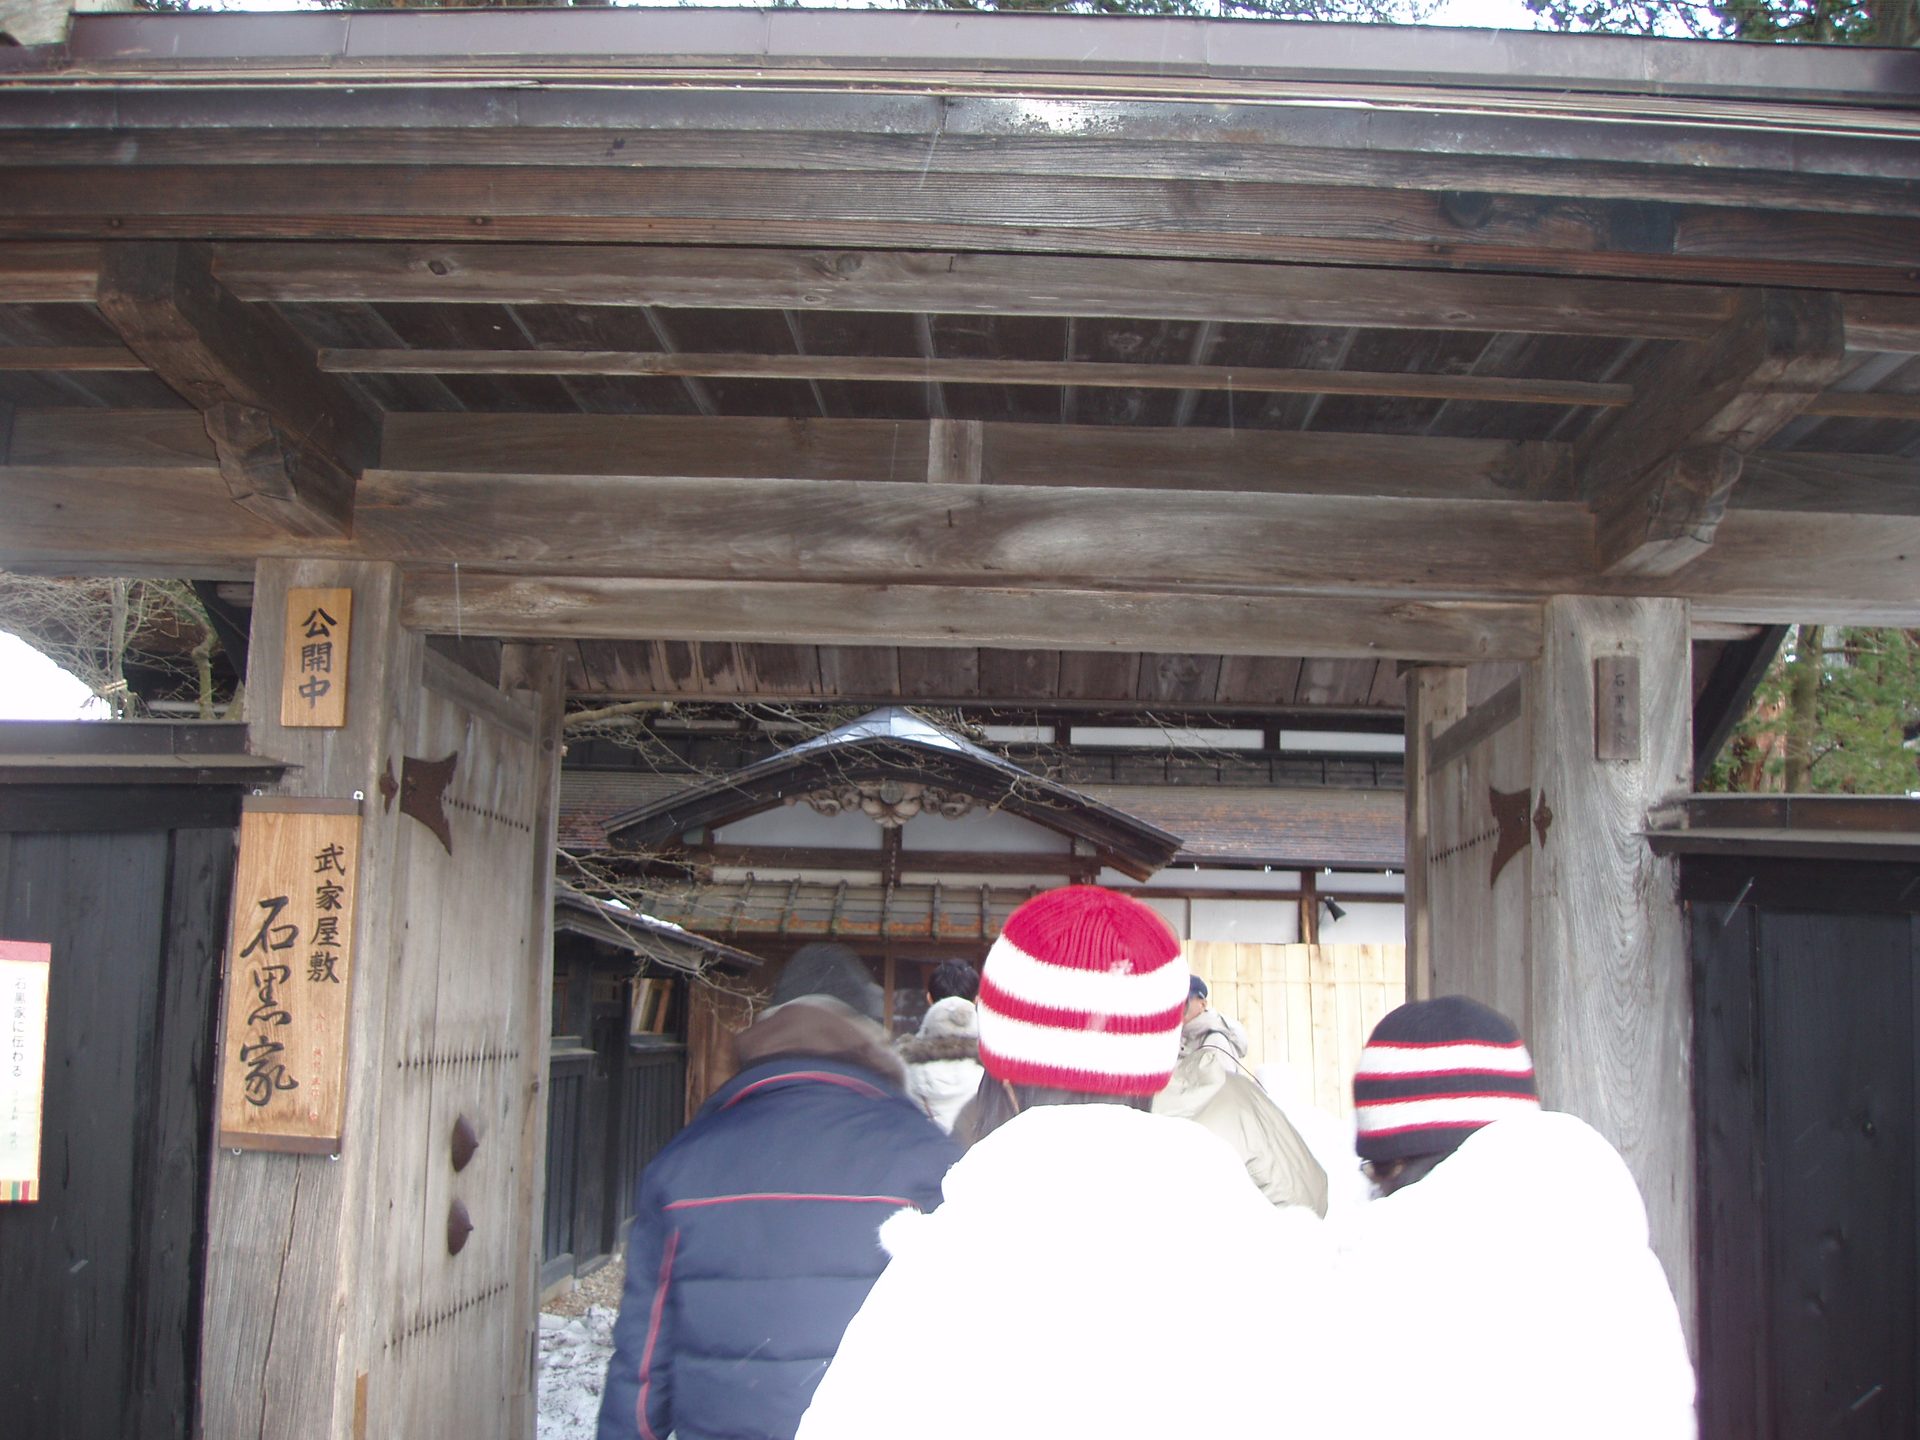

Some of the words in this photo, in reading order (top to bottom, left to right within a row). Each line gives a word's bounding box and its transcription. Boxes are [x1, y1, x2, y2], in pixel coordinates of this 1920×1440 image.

[299, 607, 338, 709] 公開中
[306, 843, 346, 985] 武家屋敷
[240, 895, 299, 1107] 石黒家
